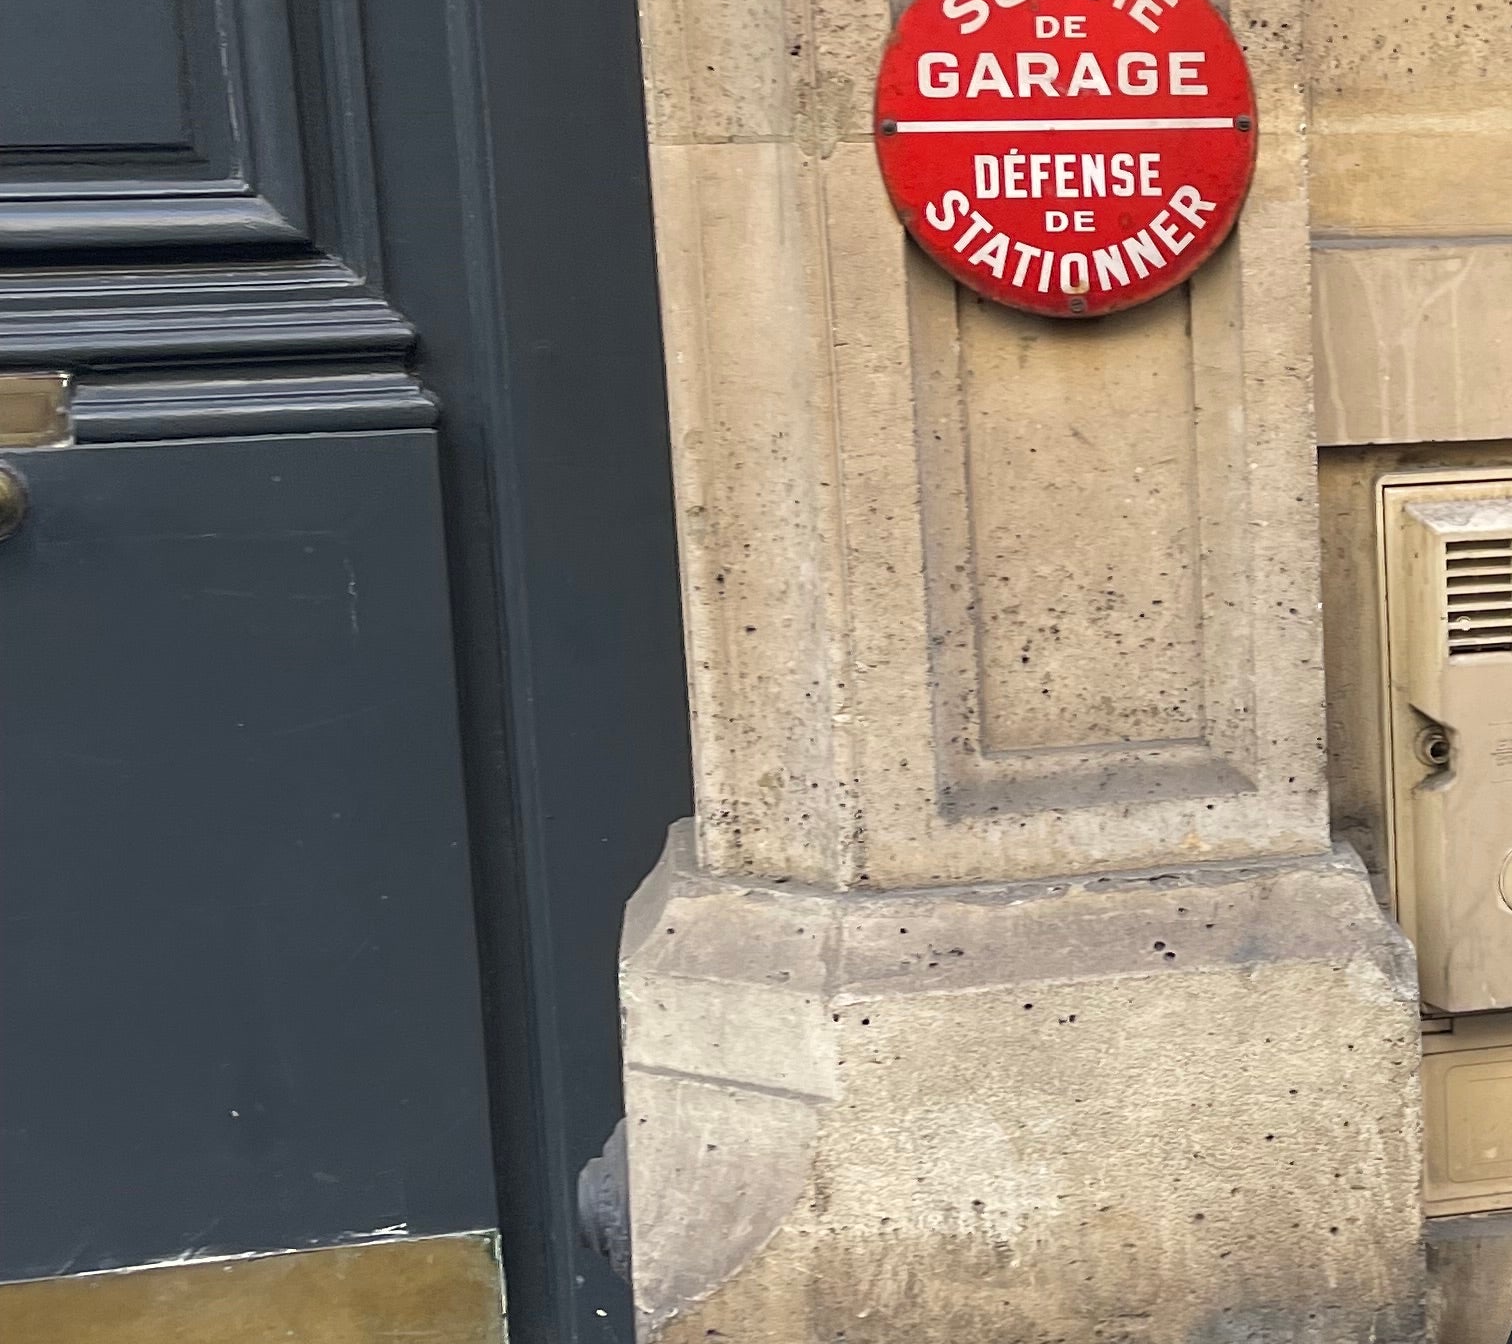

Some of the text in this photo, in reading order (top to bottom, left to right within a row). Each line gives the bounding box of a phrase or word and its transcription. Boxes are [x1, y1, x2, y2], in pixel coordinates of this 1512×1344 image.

[1035, 16, 1088, 38] DE
[917, 52, 1209, 98] GARAGE
[974, 149, 1163, 199] DÉFENSE
[926, 185, 1217, 295] STATIONNER
[1045, 211, 1096, 233] DE
